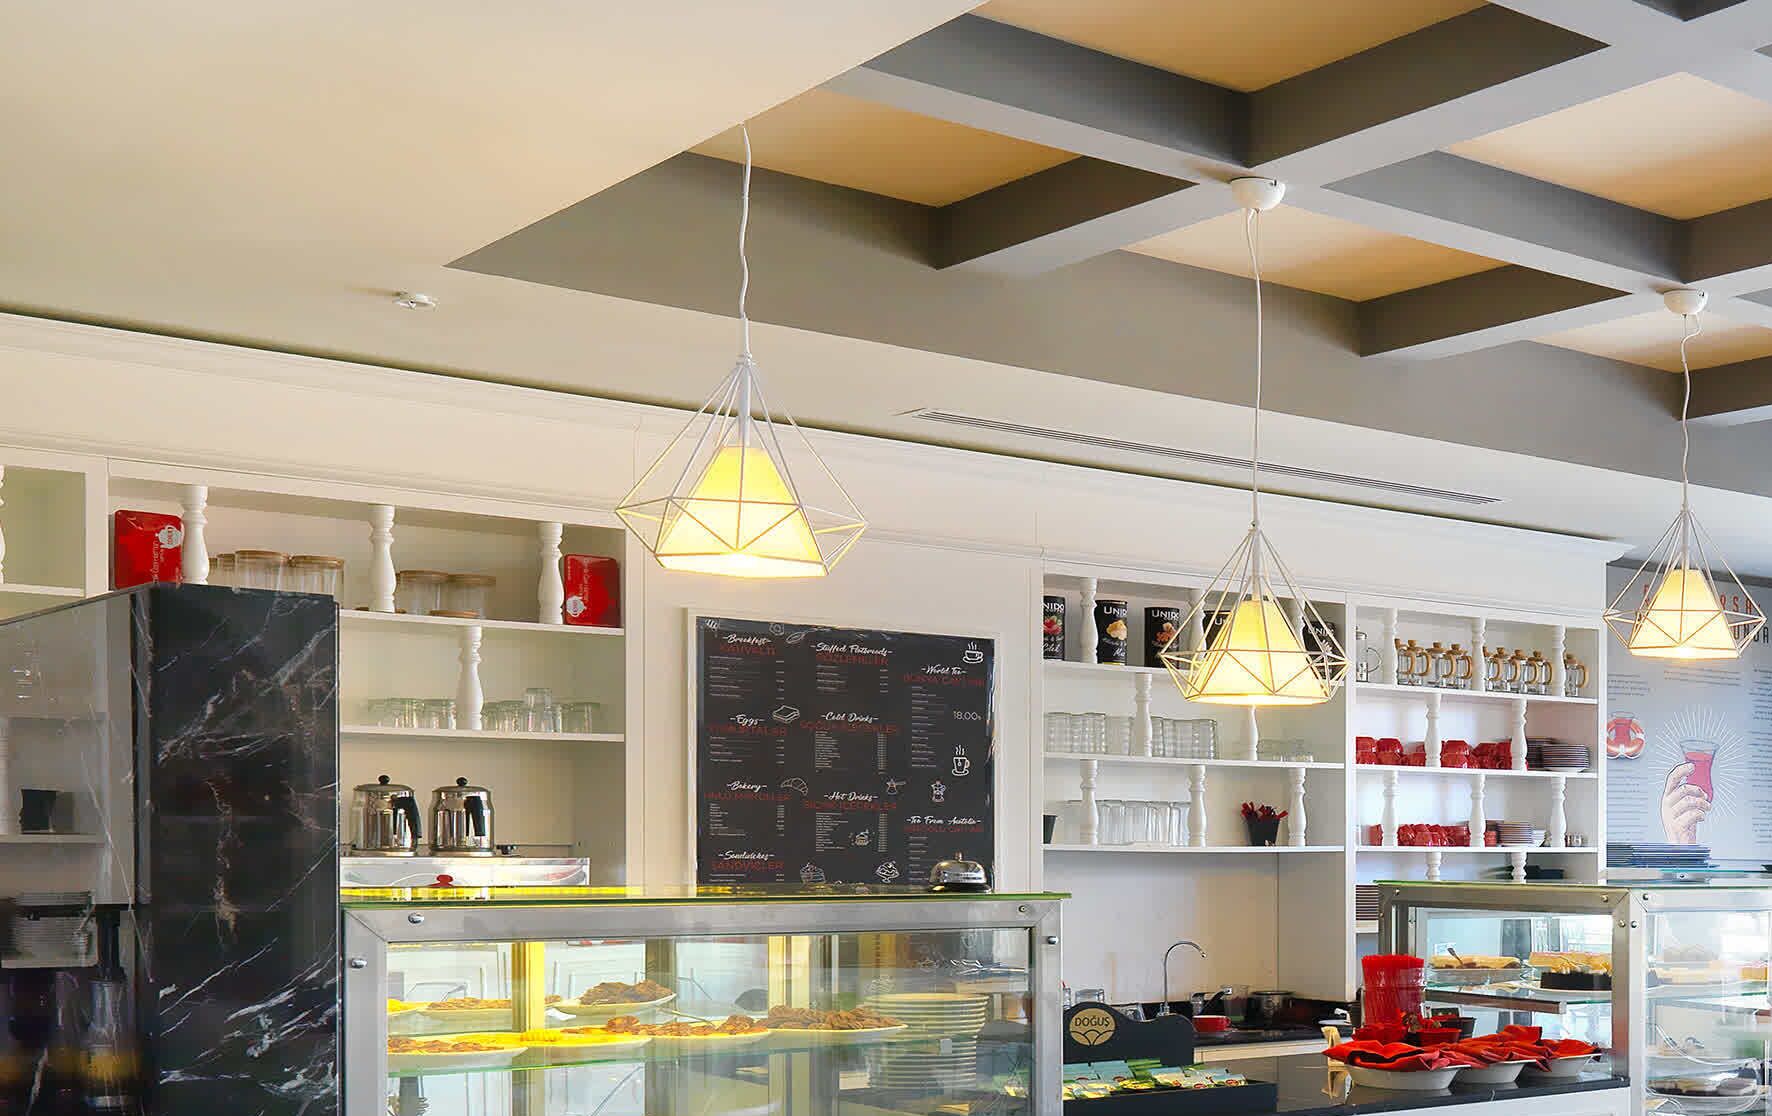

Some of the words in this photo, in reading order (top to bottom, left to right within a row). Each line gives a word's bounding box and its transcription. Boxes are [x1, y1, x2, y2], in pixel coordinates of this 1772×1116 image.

[735, 713, 759, 727] Eggs
[825, 711, 846, 721] Cold
[848, 712, 874, 724] Drinks
[729, 780, 762, 793] Bakery
[829, 791, 847, 801] Hot
[848, 791, 873, 802] Drinks
[1074, 1015, 1110, 1027] DOĞUŞ
